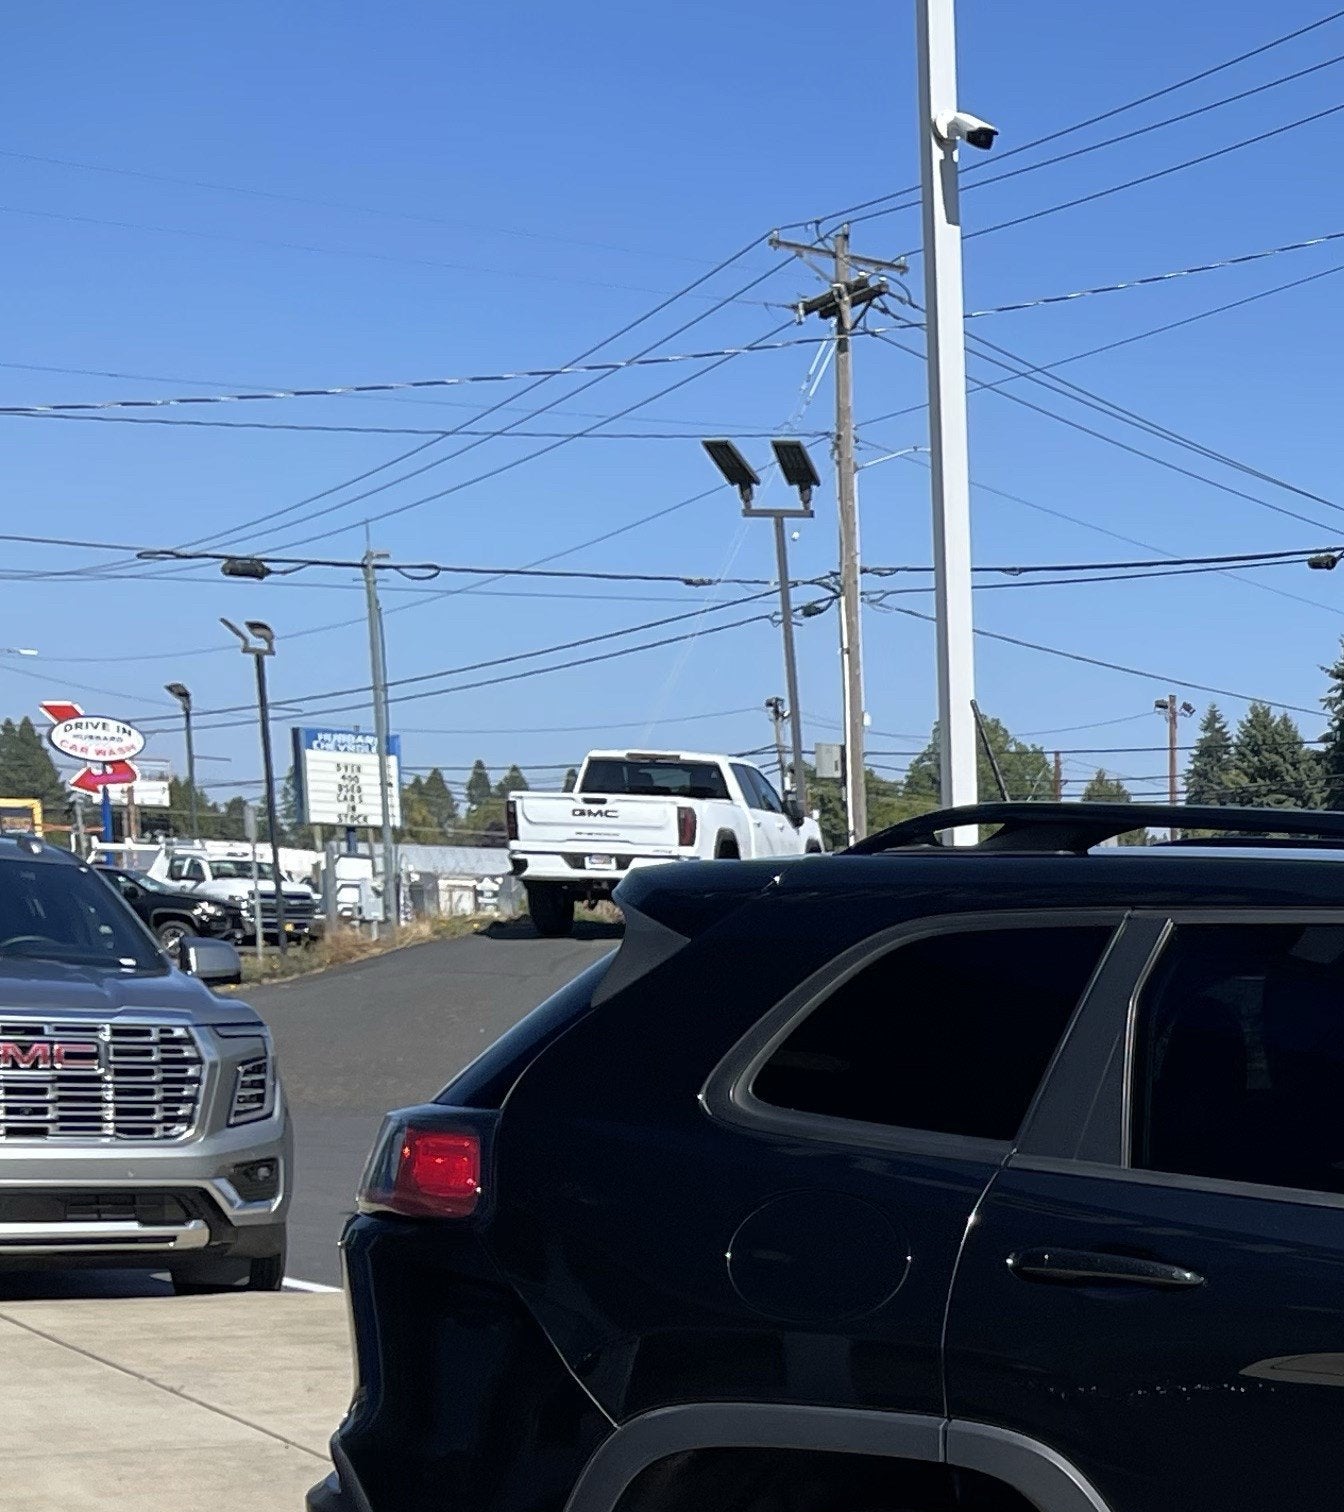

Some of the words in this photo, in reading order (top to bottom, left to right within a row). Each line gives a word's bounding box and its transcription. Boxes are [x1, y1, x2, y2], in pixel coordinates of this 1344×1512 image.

[63, 721, 110, 733] DRIVE
[116, 725, 132, 737] IN
[60, 740, 89, 754] CAR
[94, 744, 137, 756] WASH
[572, 808, 620, 818] GMC
[0, 1043, 98, 1069] MC
